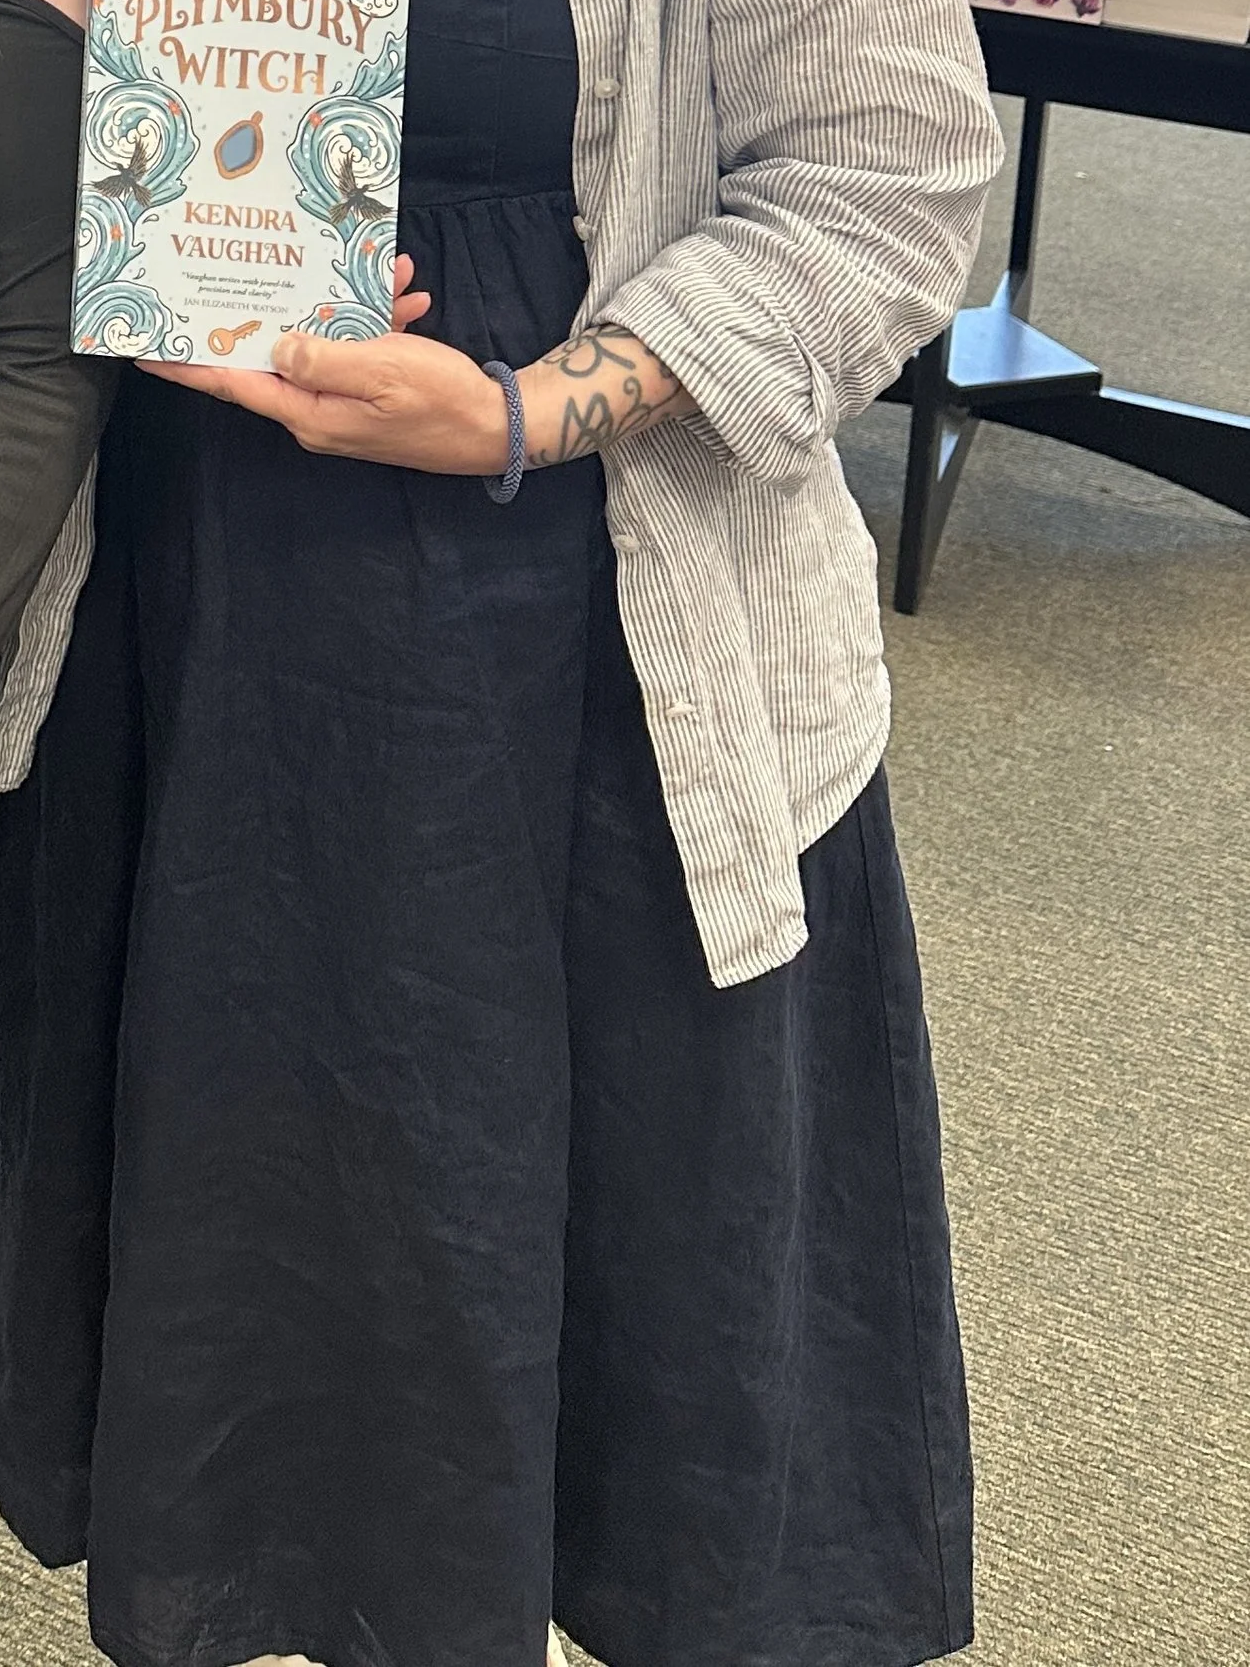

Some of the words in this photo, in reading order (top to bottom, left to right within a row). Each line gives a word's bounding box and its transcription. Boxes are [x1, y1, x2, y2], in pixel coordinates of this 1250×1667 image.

[159, 37, 327, 95] WITCH
[183, 201, 297, 233] KENDRA
[171, 234, 305, 268] VAUGHAN
[198, 286, 230, 294] precision
[232, 288, 247, 296] and
[259, 279, 295, 289] jewel-like
[184, 297, 199, 306] JAN
[201, 298, 250, 310] ELIZABETH
[251, 304, 290, 314] WATSON
